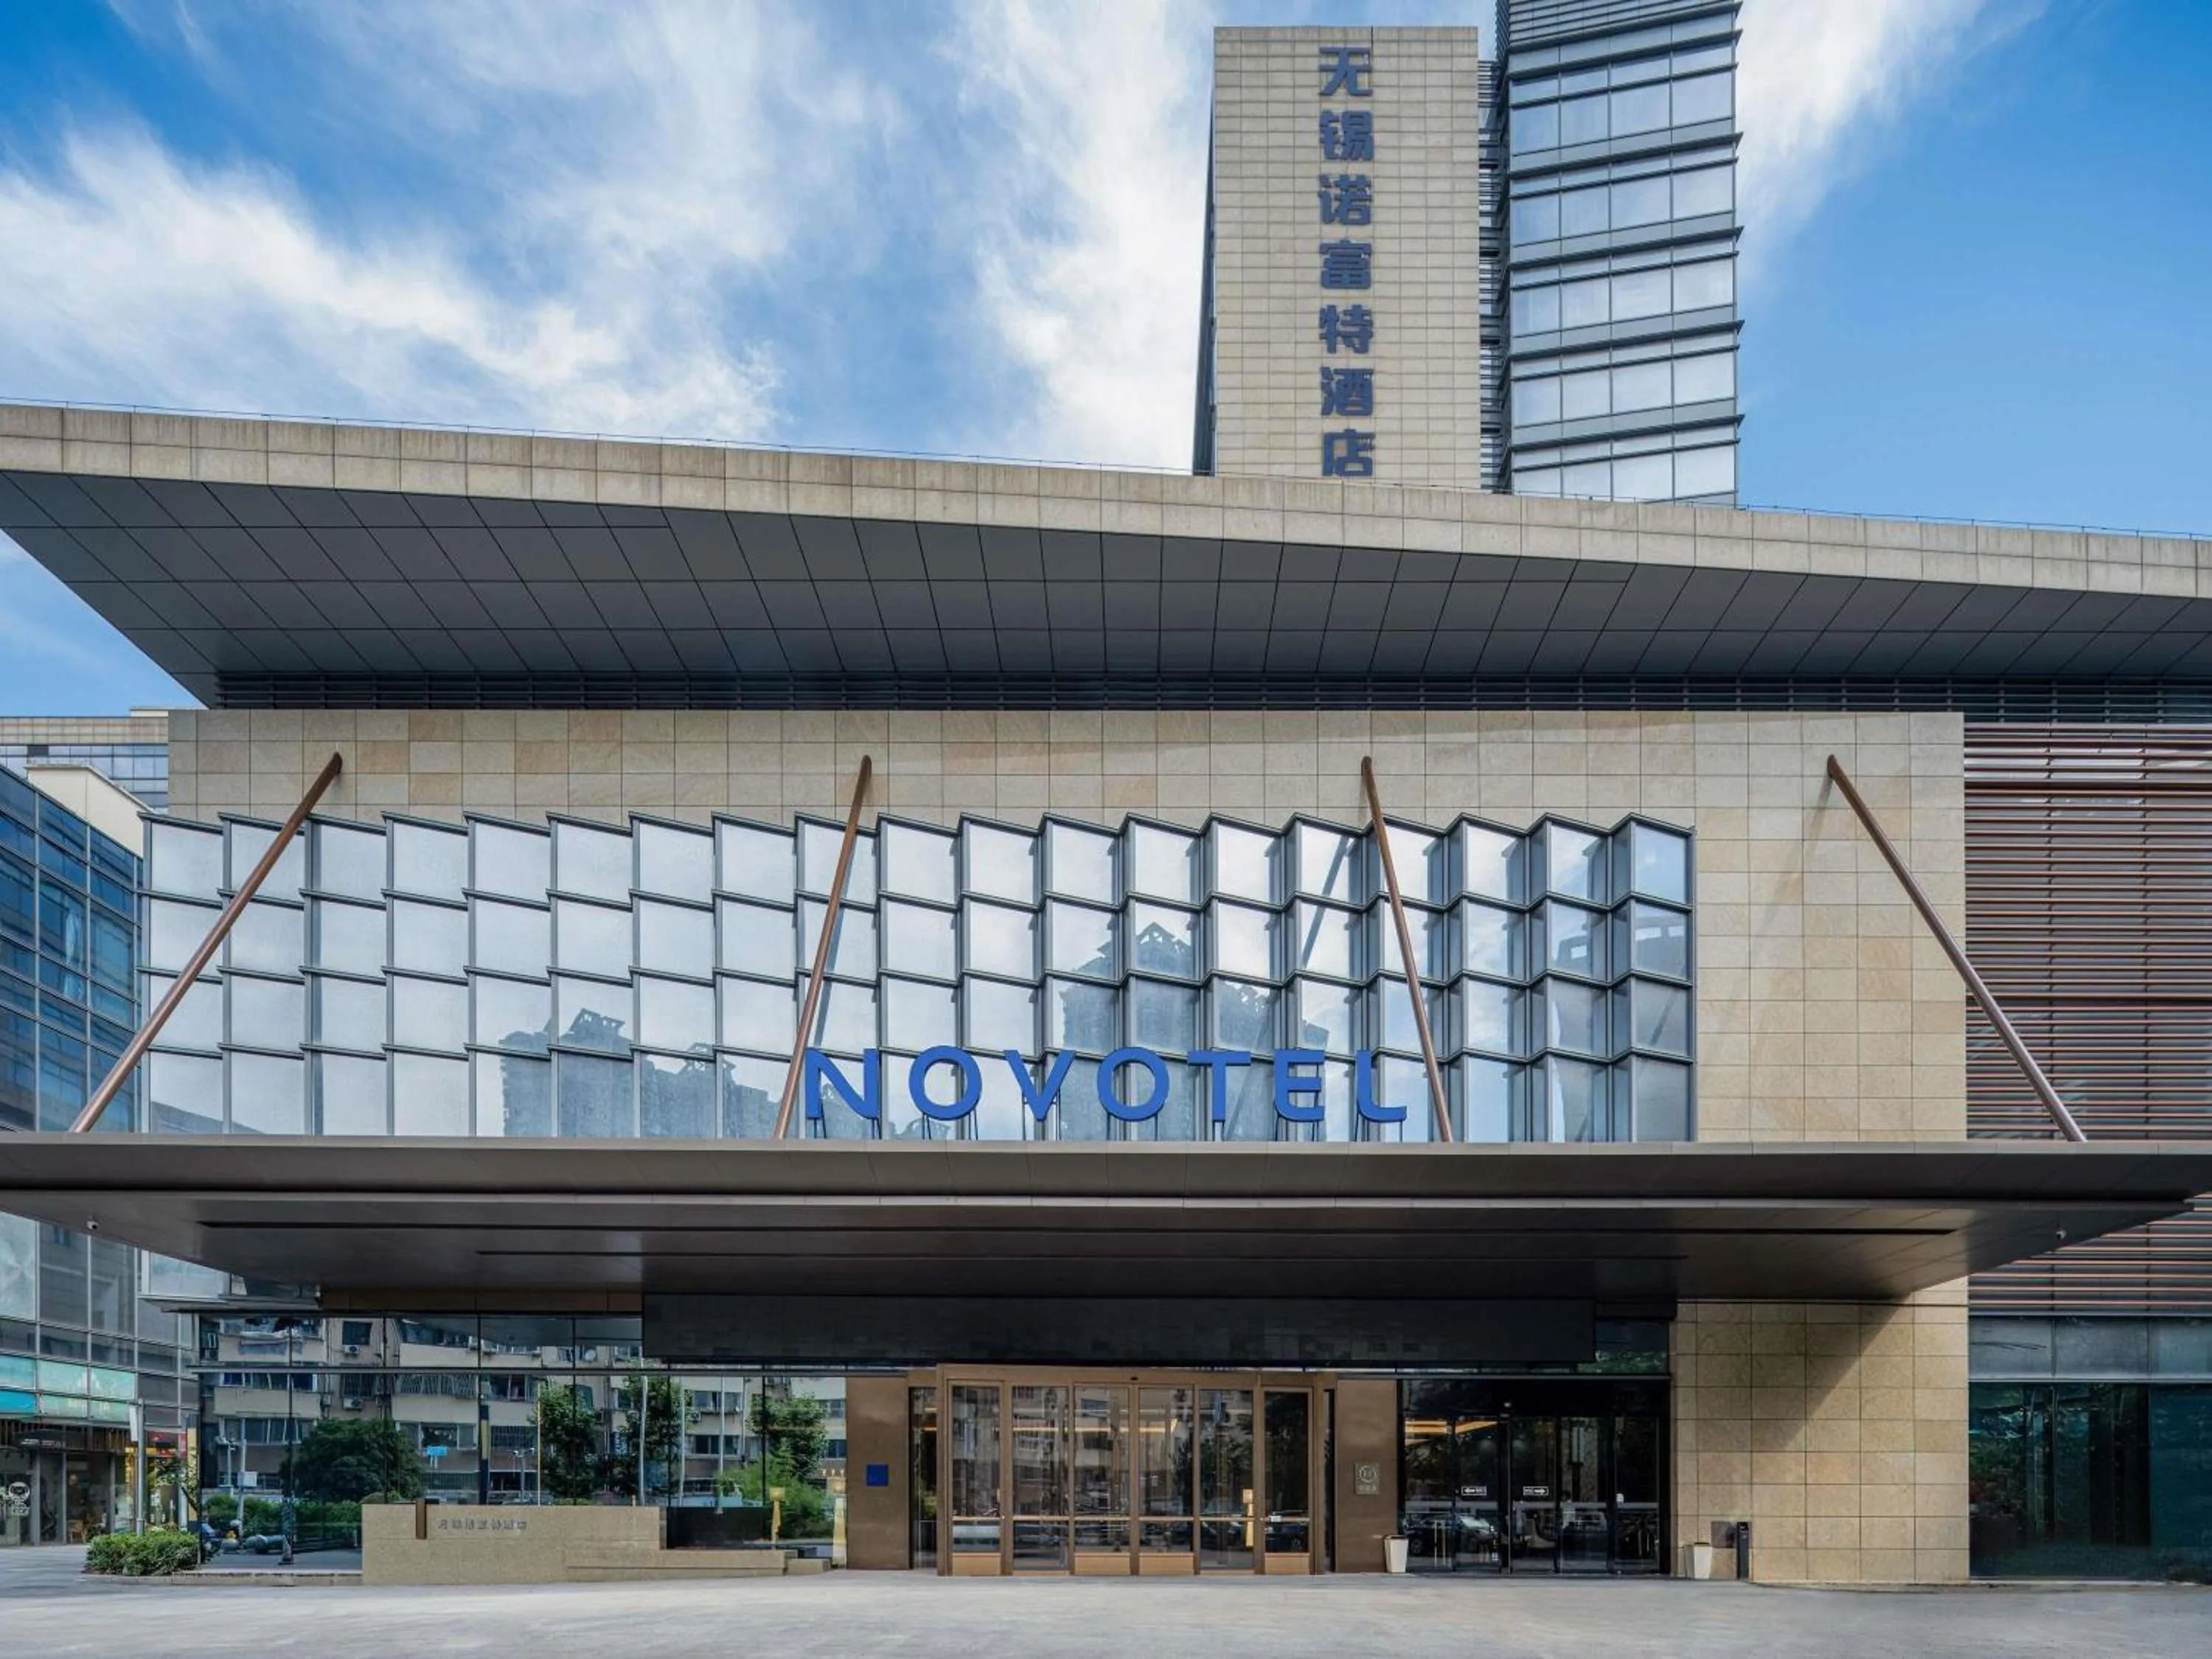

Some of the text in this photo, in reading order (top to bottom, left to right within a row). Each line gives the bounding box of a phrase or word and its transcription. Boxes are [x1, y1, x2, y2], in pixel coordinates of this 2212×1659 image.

[1318, 46, 1375, 478] 无锡诺富特酒店
[805, 1046, 1408, 1122] NOVOTEL
